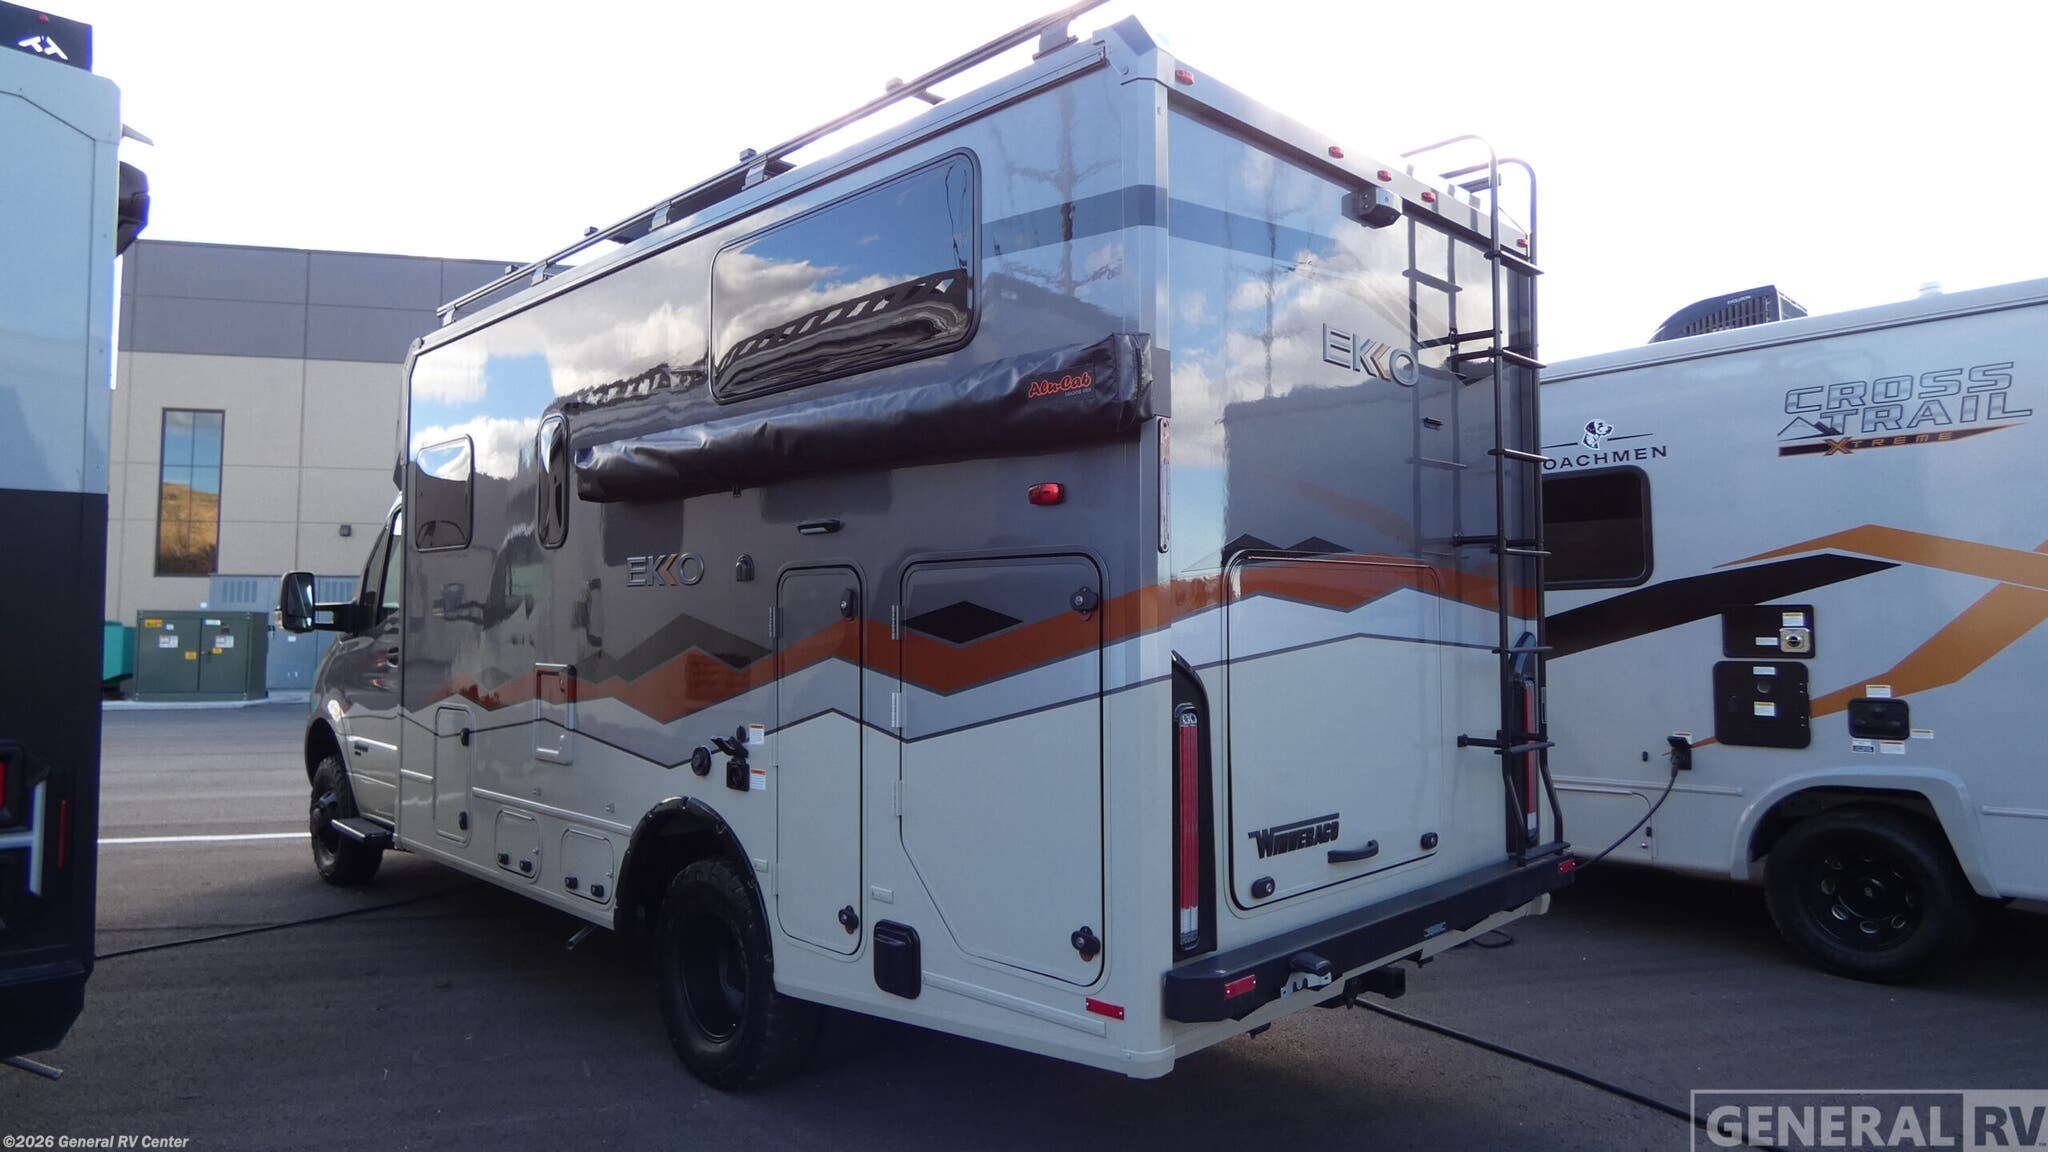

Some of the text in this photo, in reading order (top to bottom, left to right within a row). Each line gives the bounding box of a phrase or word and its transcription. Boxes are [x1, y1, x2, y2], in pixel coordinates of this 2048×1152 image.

[1027, 371, 1092, 398] Alu-Cab
[1784, 361, 2015, 415] CROSS
[1819, 391, 2033, 436] TRAIL
[1542, 445, 1668, 471] OACHMEN
[1823, 432, 1953, 456] XTREME
[626, 552, 704, 586] EKKO
